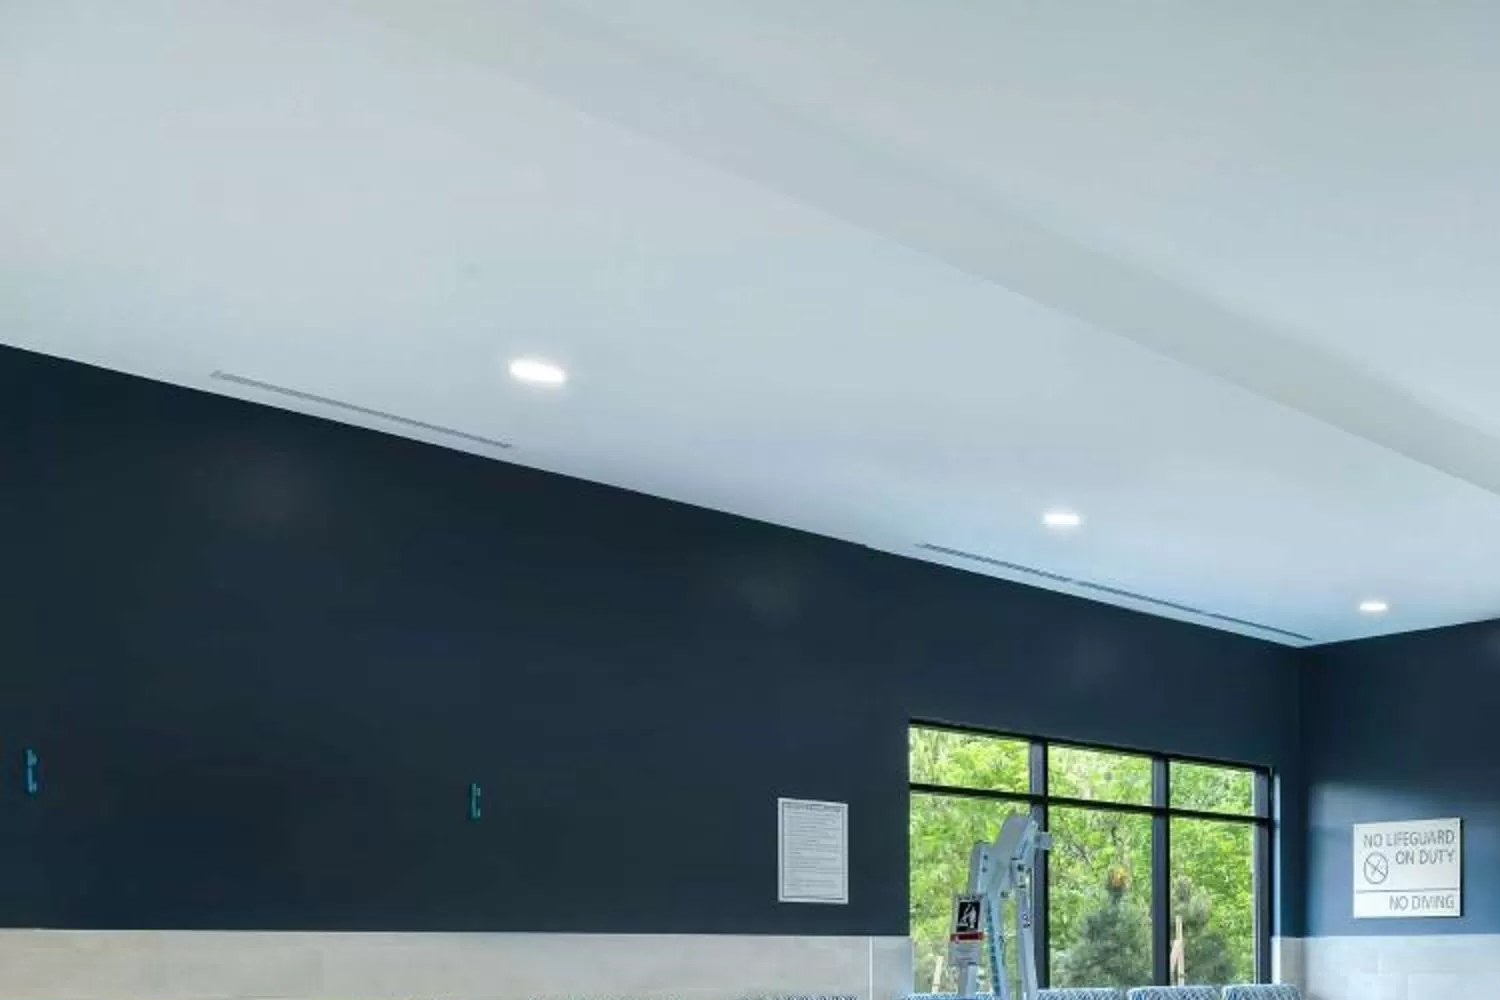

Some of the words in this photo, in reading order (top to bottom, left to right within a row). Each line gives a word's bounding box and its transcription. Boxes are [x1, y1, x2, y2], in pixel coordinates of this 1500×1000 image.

[1363, 833, 1383, 848] NO
[1386, 830, 1455, 847] LIFEGUARD
[1395, 850, 1415, 865] ON
[1419, 848, 1456, 865] DUTY
[1389, 895, 1409, 911] NO
[1411, 895, 1455, 910] DIVING
